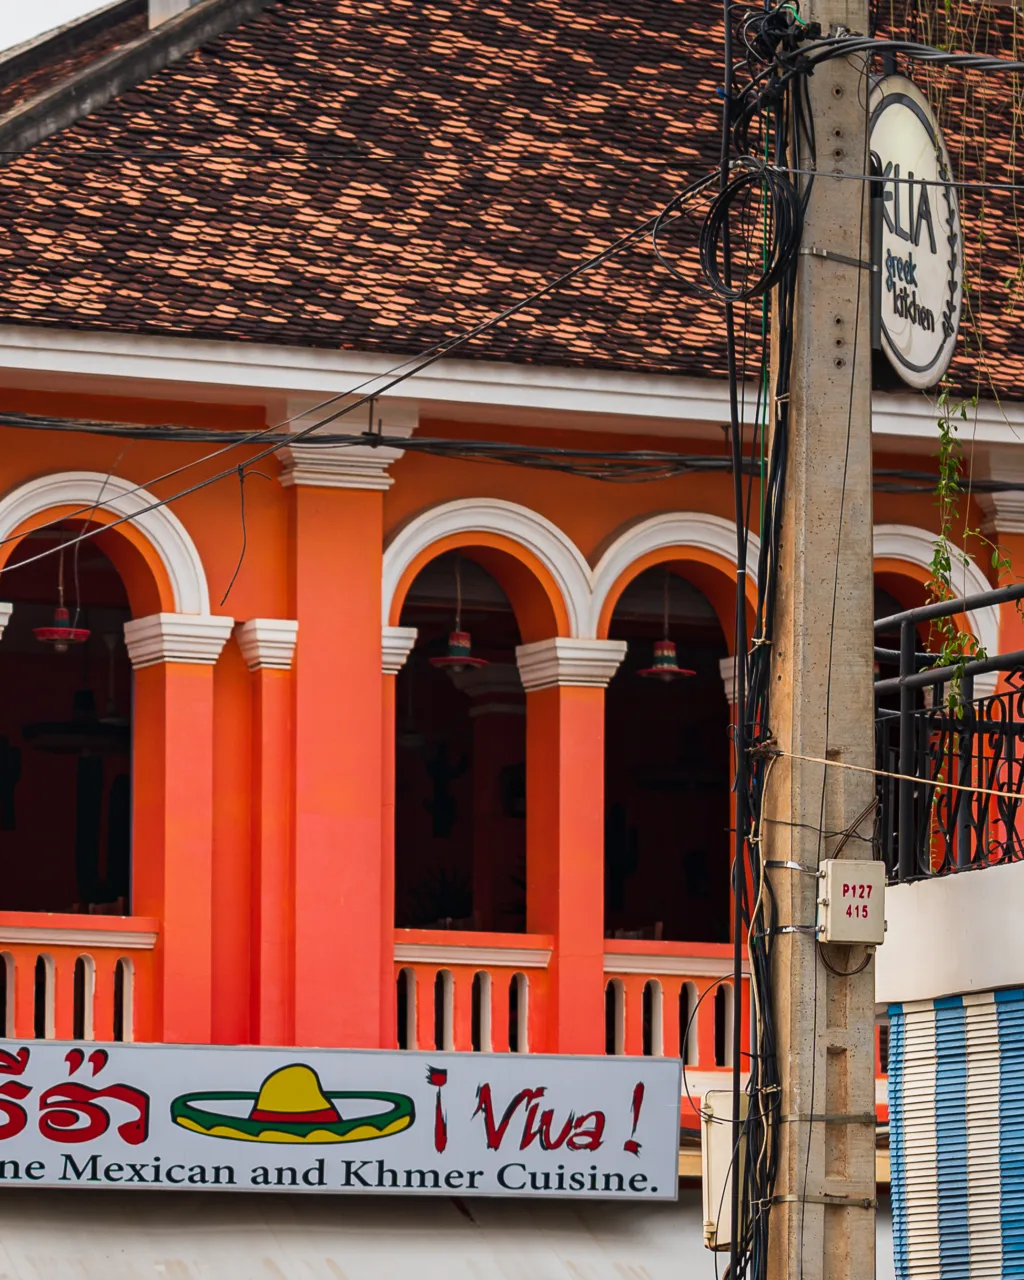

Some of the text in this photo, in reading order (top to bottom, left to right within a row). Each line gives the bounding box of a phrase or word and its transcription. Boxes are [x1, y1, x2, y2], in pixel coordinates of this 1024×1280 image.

[885, 248, 918, 293] greek
[892, 281, 935, 334] kitchen
[842, 883, 873, 899] P127
[846, 904, 869, 919] 415
[58, 1153, 238, 1186] Mexican
[250, 1157, 327, 1188] and
[340, 1159, 484, 1190] Khmer
[496, 1162, 659, 1193] Cuisine.
